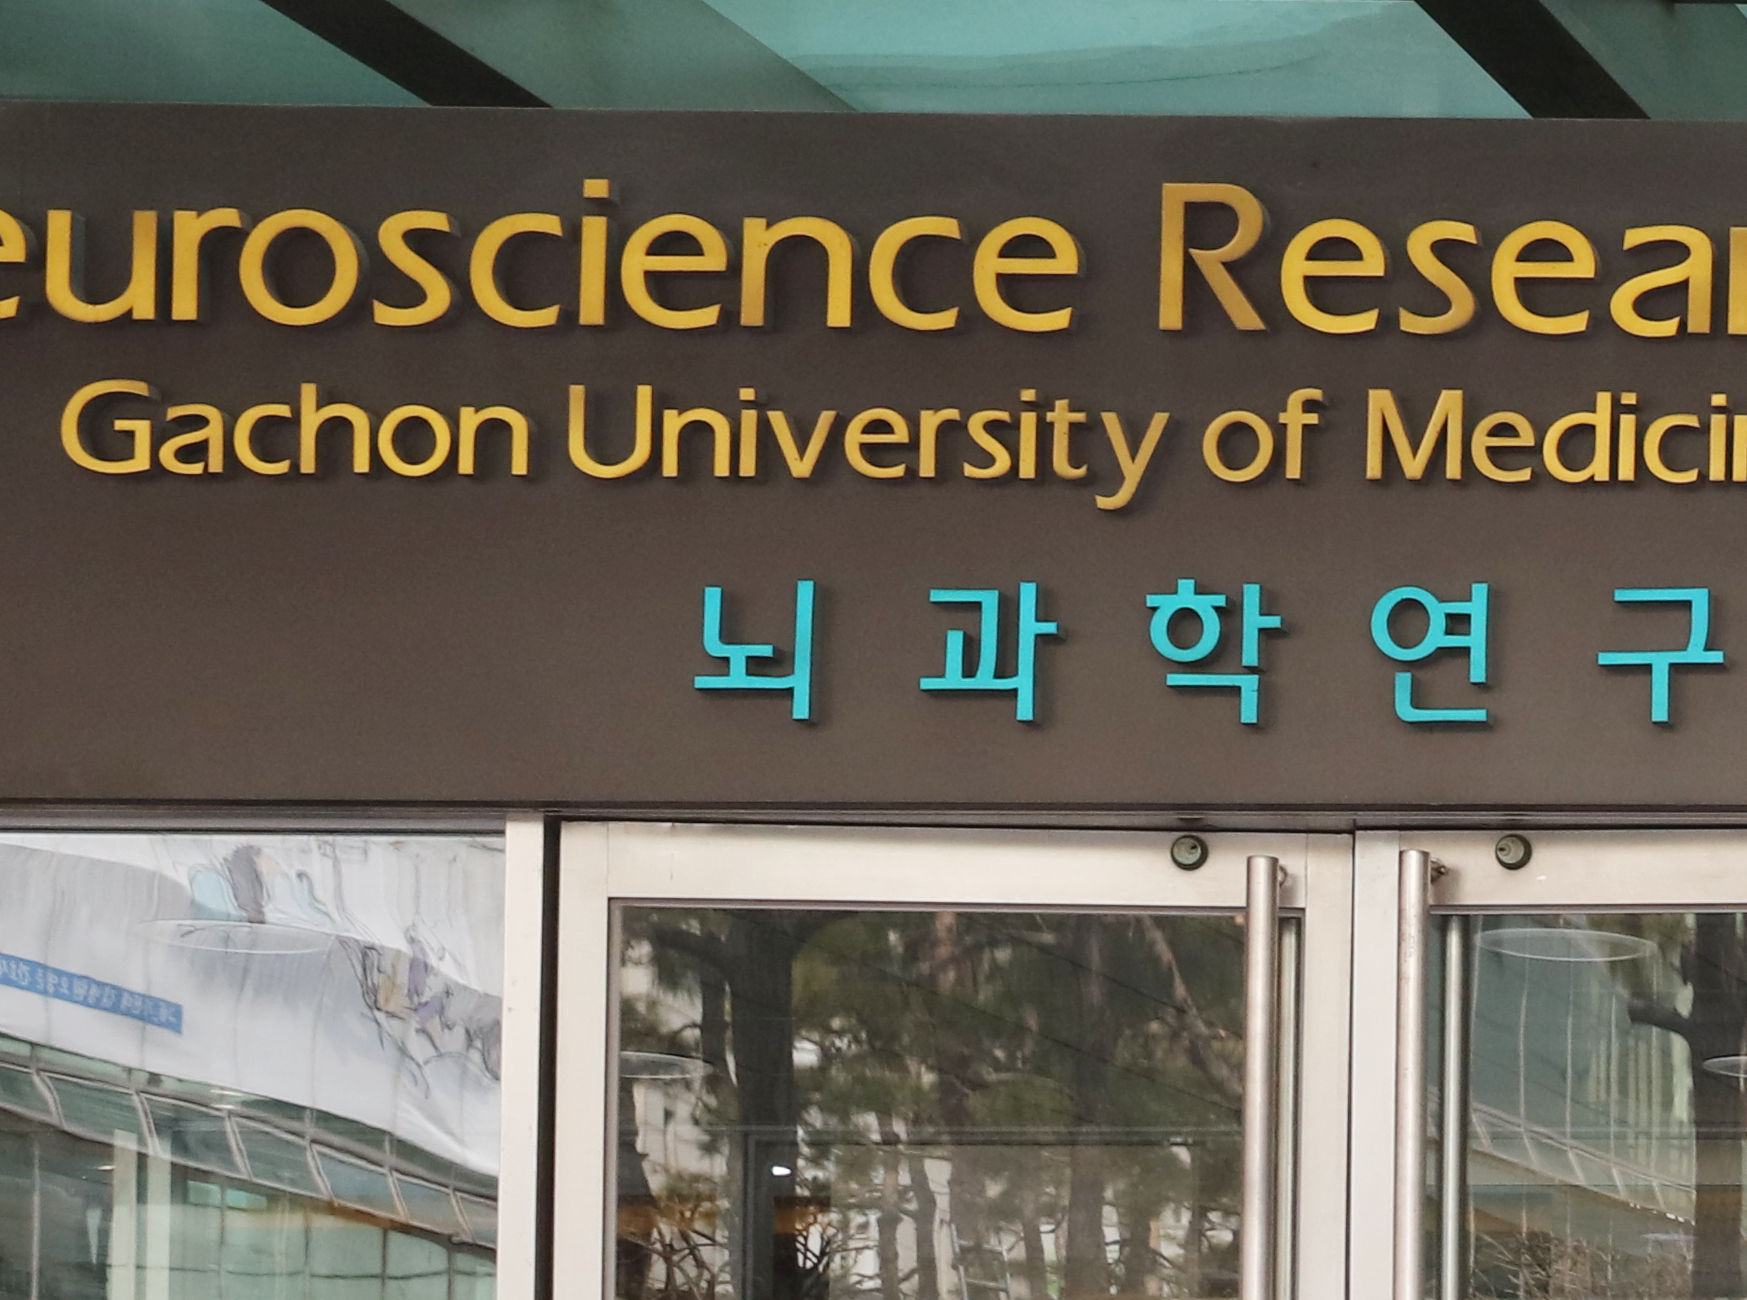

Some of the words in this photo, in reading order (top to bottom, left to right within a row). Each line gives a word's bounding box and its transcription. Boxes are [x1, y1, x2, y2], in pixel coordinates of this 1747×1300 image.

[0, 179, 1079, 332] uroscience
[61, 379, 528, 478] Gachon
[568, 385, 1169, 511] University
[1202, 388, 1323, 482] of
